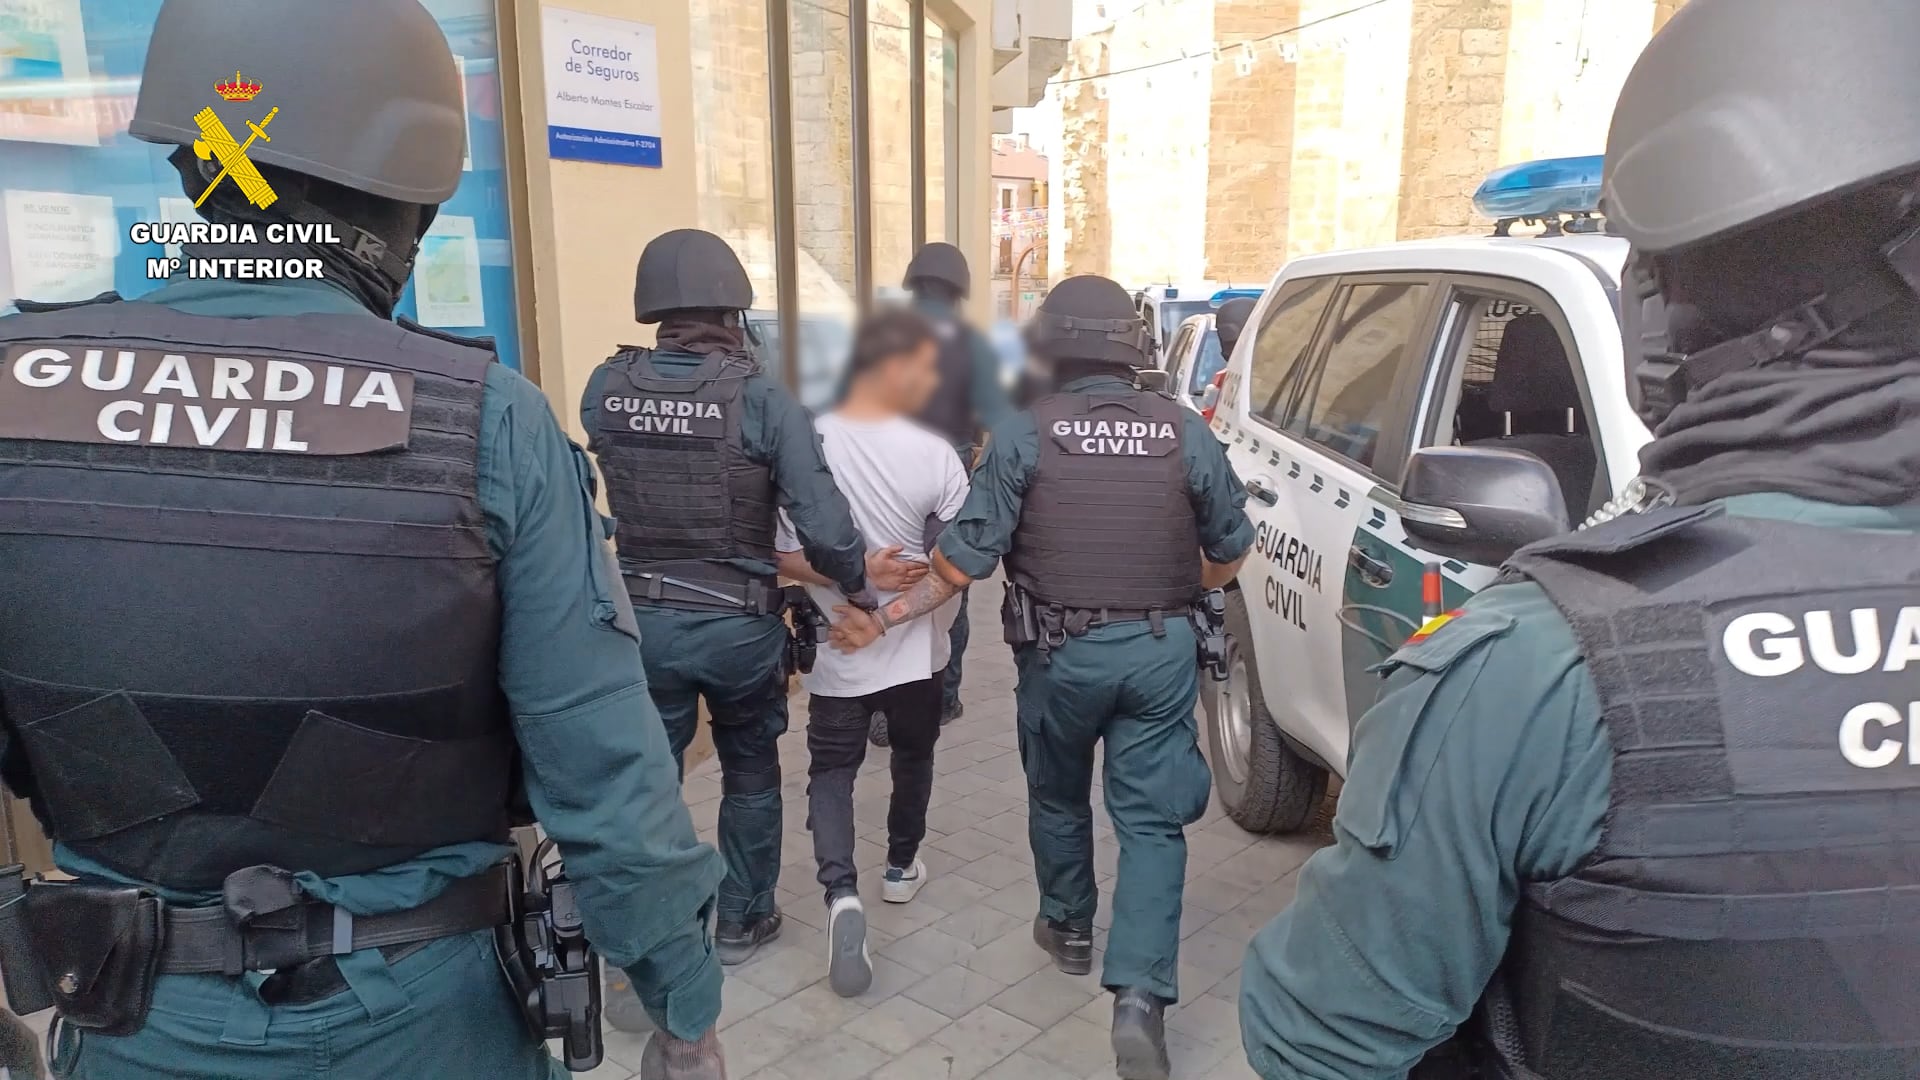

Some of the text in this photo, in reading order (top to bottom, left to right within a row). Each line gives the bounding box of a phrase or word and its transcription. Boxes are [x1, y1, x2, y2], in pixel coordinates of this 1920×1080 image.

[571, 39, 632, 62] Corredor
[565, 56, 640, 82] de Seguros
[556, 91, 589, 104] Alberto
[591, 96, 622, 109] Montes
[12, 348, 404, 412] GUARDIA
[604, 396, 723, 419] GUARDIA
[97, 400, 308, 452] CIVIL
[629, 415, 694, 435] CIVIL
[1052, 420, 1176, 439] GUARDIA
[1081, 438, 1149, 455] CIVIL
[1255, 520, 1322, 594] GUARDIA
[1265, 575, 1307, 632] CIVIL
